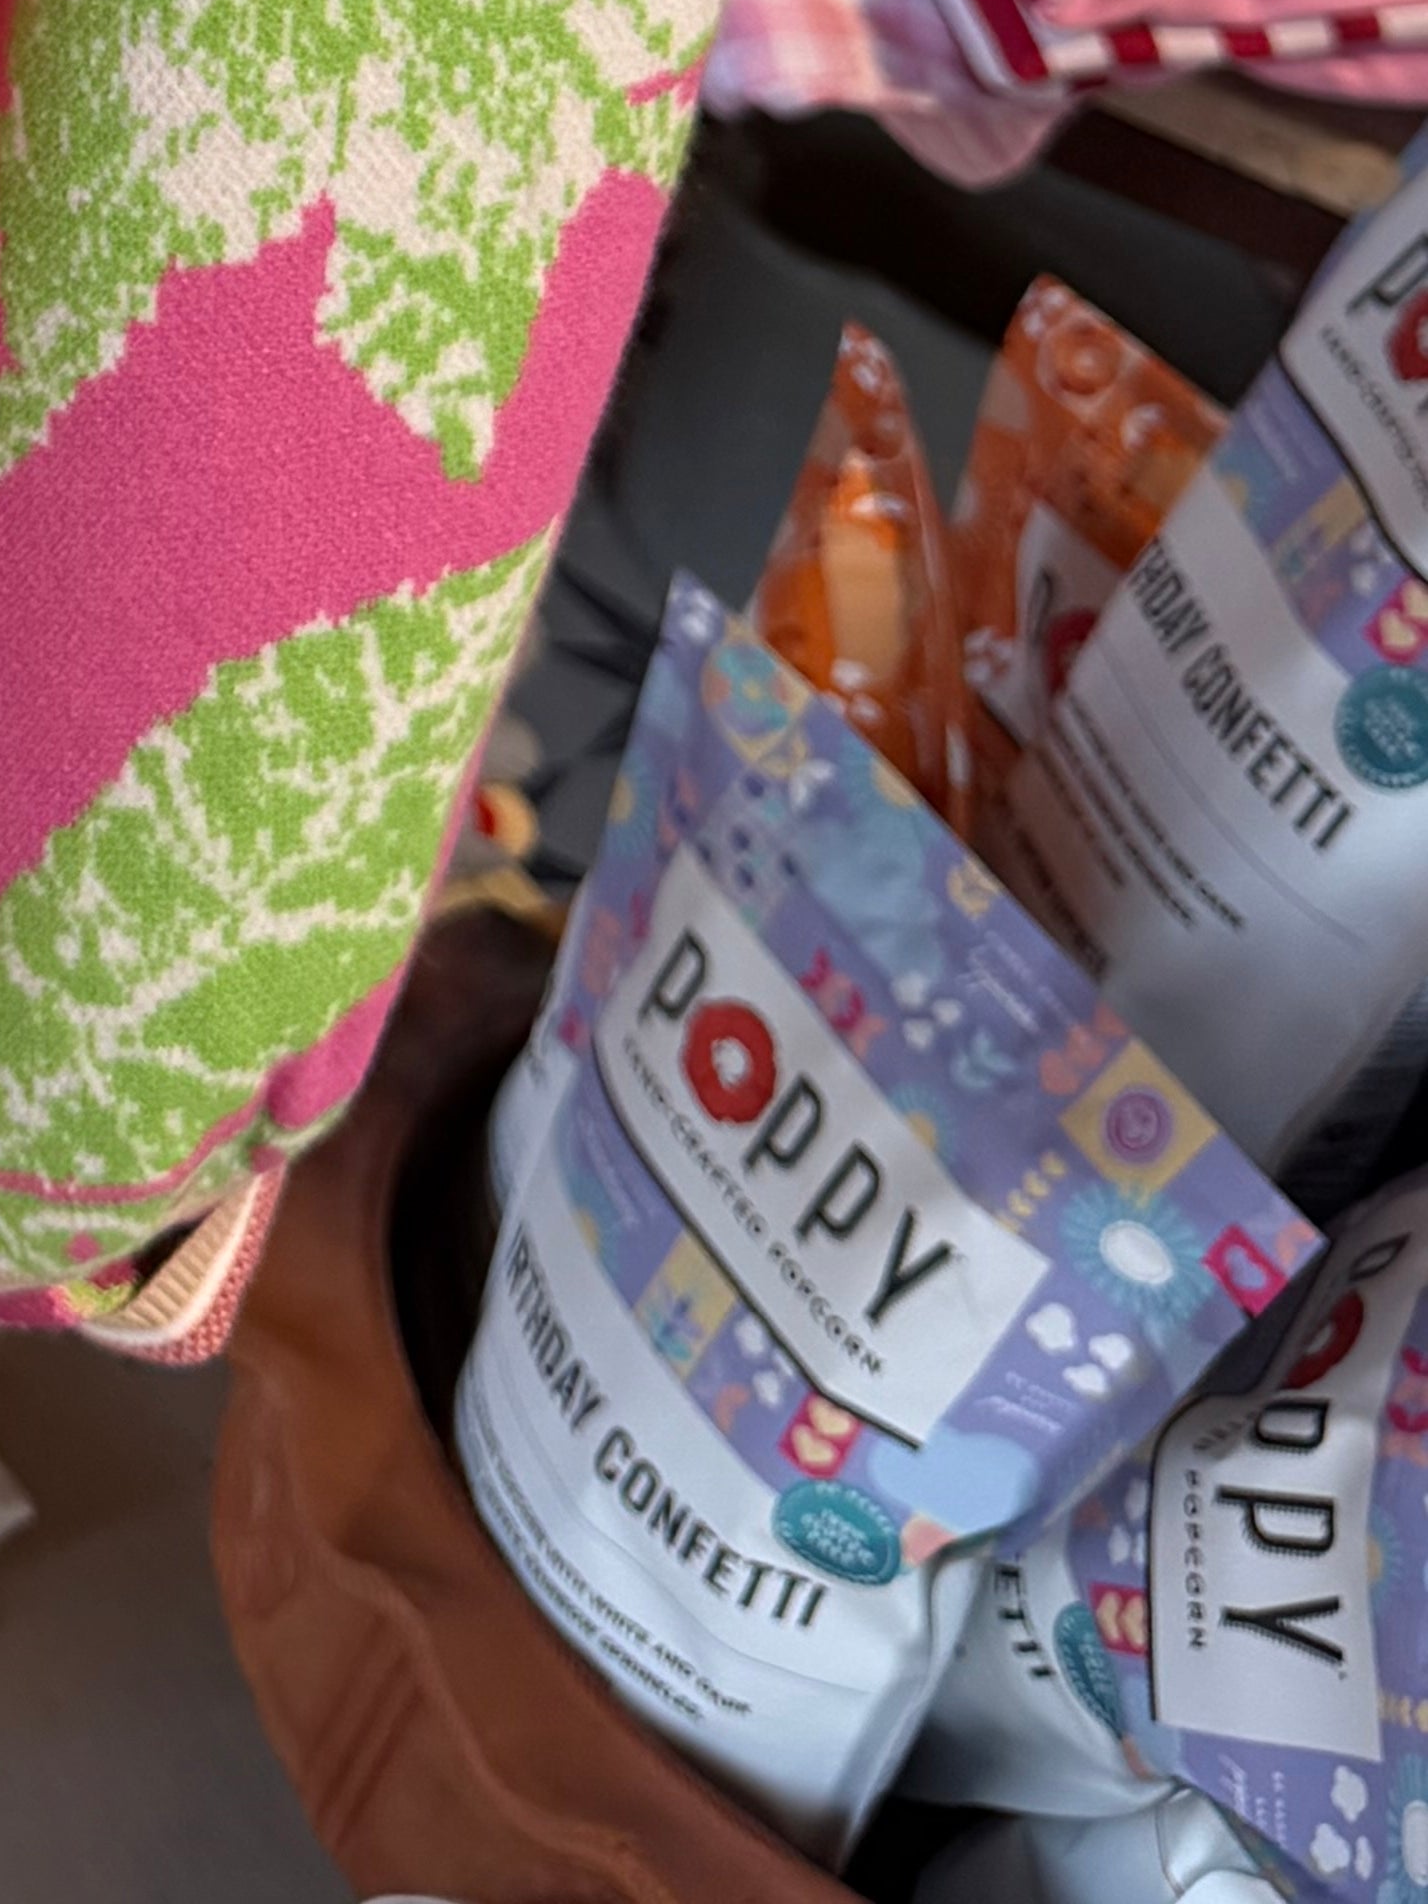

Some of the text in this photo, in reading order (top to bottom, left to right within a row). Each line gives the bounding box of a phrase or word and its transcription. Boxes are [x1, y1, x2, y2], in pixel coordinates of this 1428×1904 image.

[1179, 641, 1354, 854] CONFETTI
[639, 926, 958, 1329] POPPY
[767, 1241, 886, 1377] POPCORN
[592, 1424, 832, 1629] CONFETTI
